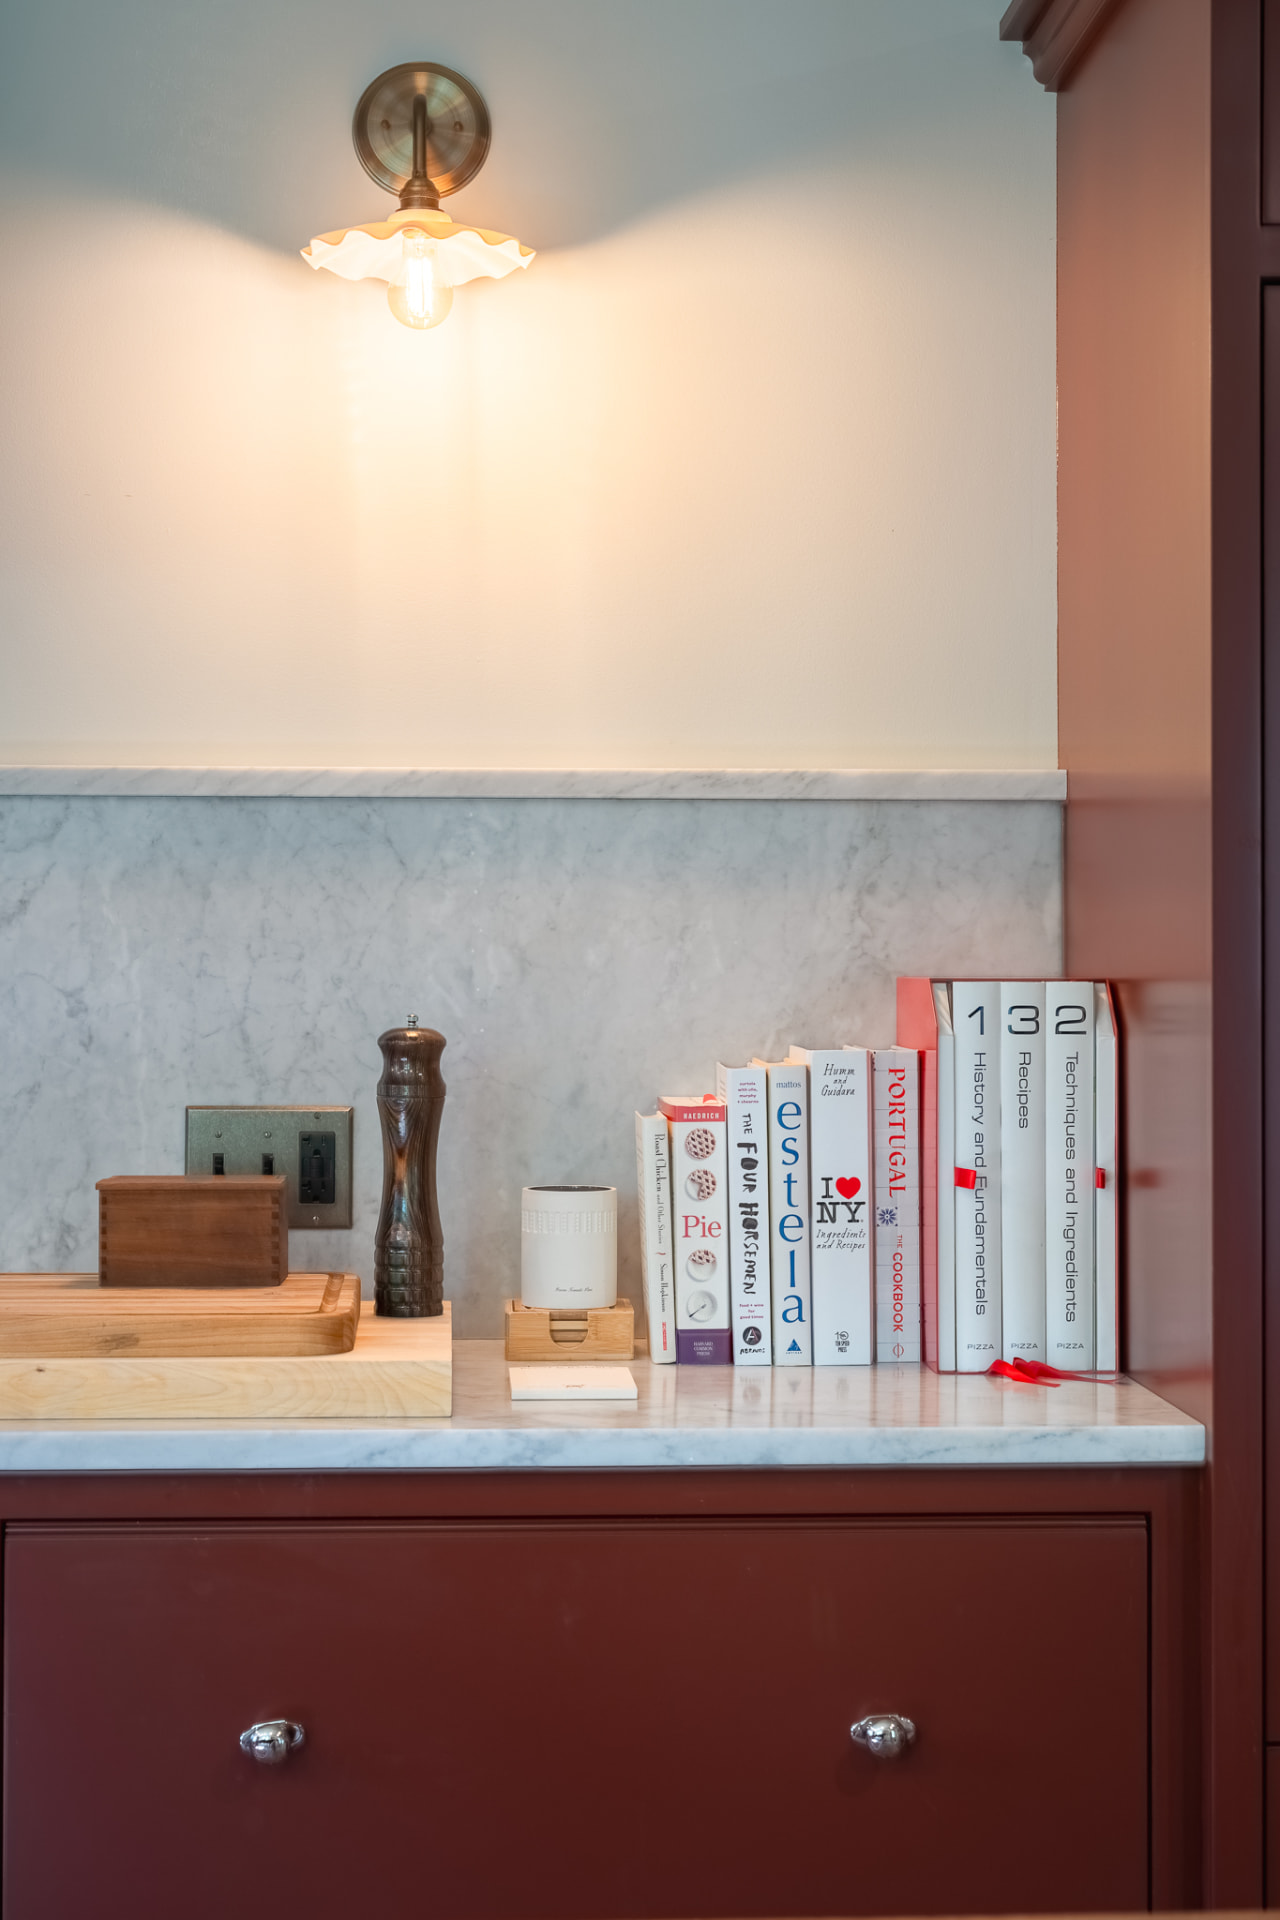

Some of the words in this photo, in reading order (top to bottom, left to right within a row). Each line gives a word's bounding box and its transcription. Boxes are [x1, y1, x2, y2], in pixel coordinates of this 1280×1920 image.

[968, 1005, 985, 1036] 1
[1007, 1005, 1040, 1035] 3
[1054, 1005, 1087, 1035] 2
[776, 1081, 802, 1089] mattos
[823, 1063, 855, 1076] Humm
[833, 1075, 848, 1084] and
[821, 1084, 855, 1096] Guidara
[971, 1052, 987, 1125] History
[1016, 1051, 1032, 1129] Recipes
[683, 1112, 720, 1120] HAEDRICH
[1063, 1051, 1079, 1160] Techniques
[742, 1113, 753, 1134] THE
[888, 1067, 906, 1199] PORTUGAL
[655, 1133, 666, 1155] Roast
[974, 1132, 987, 1168] and
[655, 1158, 667, 1192] Chicken
[737, 1142, 759, 1194] FOUR
[821, 1177, 834, 1199] I
[1065, 1168, 1078, 1204] and
[681, 1215, 722, 1238] Pie
[776, 1101, 806, 1324] estela
[738, 1202, 759, 1294] HORSEMEN
[816, 1227, 866, 1243] Ingredients
[816, 1240, 835, 1249] and
[835, 1240, 866, 1252] Recipes
[974, 1175, 988, 1316] Fundamentals
[1062, 1211, 1078, 1322] Ingredients
[892, 1252, 904, 1332] COOKBOOK
